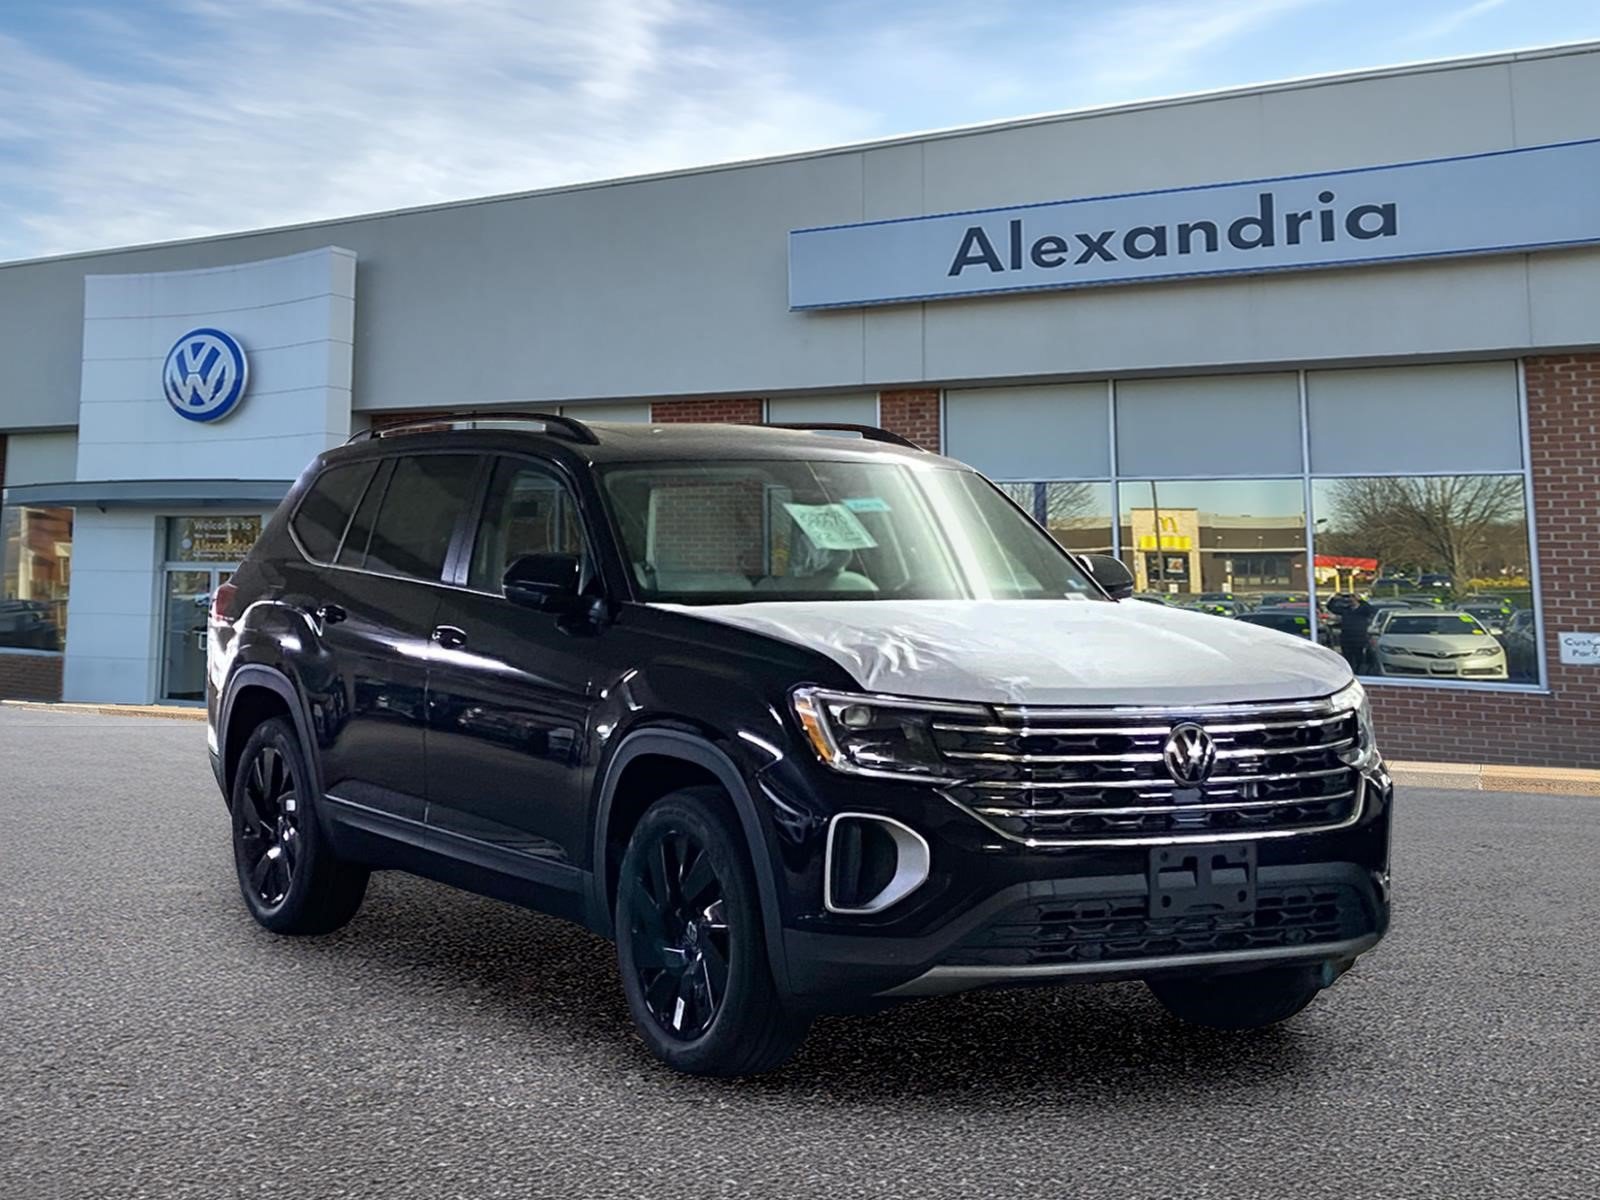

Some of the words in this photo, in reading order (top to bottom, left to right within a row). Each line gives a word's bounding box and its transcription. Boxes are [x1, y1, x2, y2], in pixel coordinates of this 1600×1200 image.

[947, 191, 1399, 277] Alexandria
[167, 332, 238, 414] VW
[1166, 725, 1214, 784] VW
